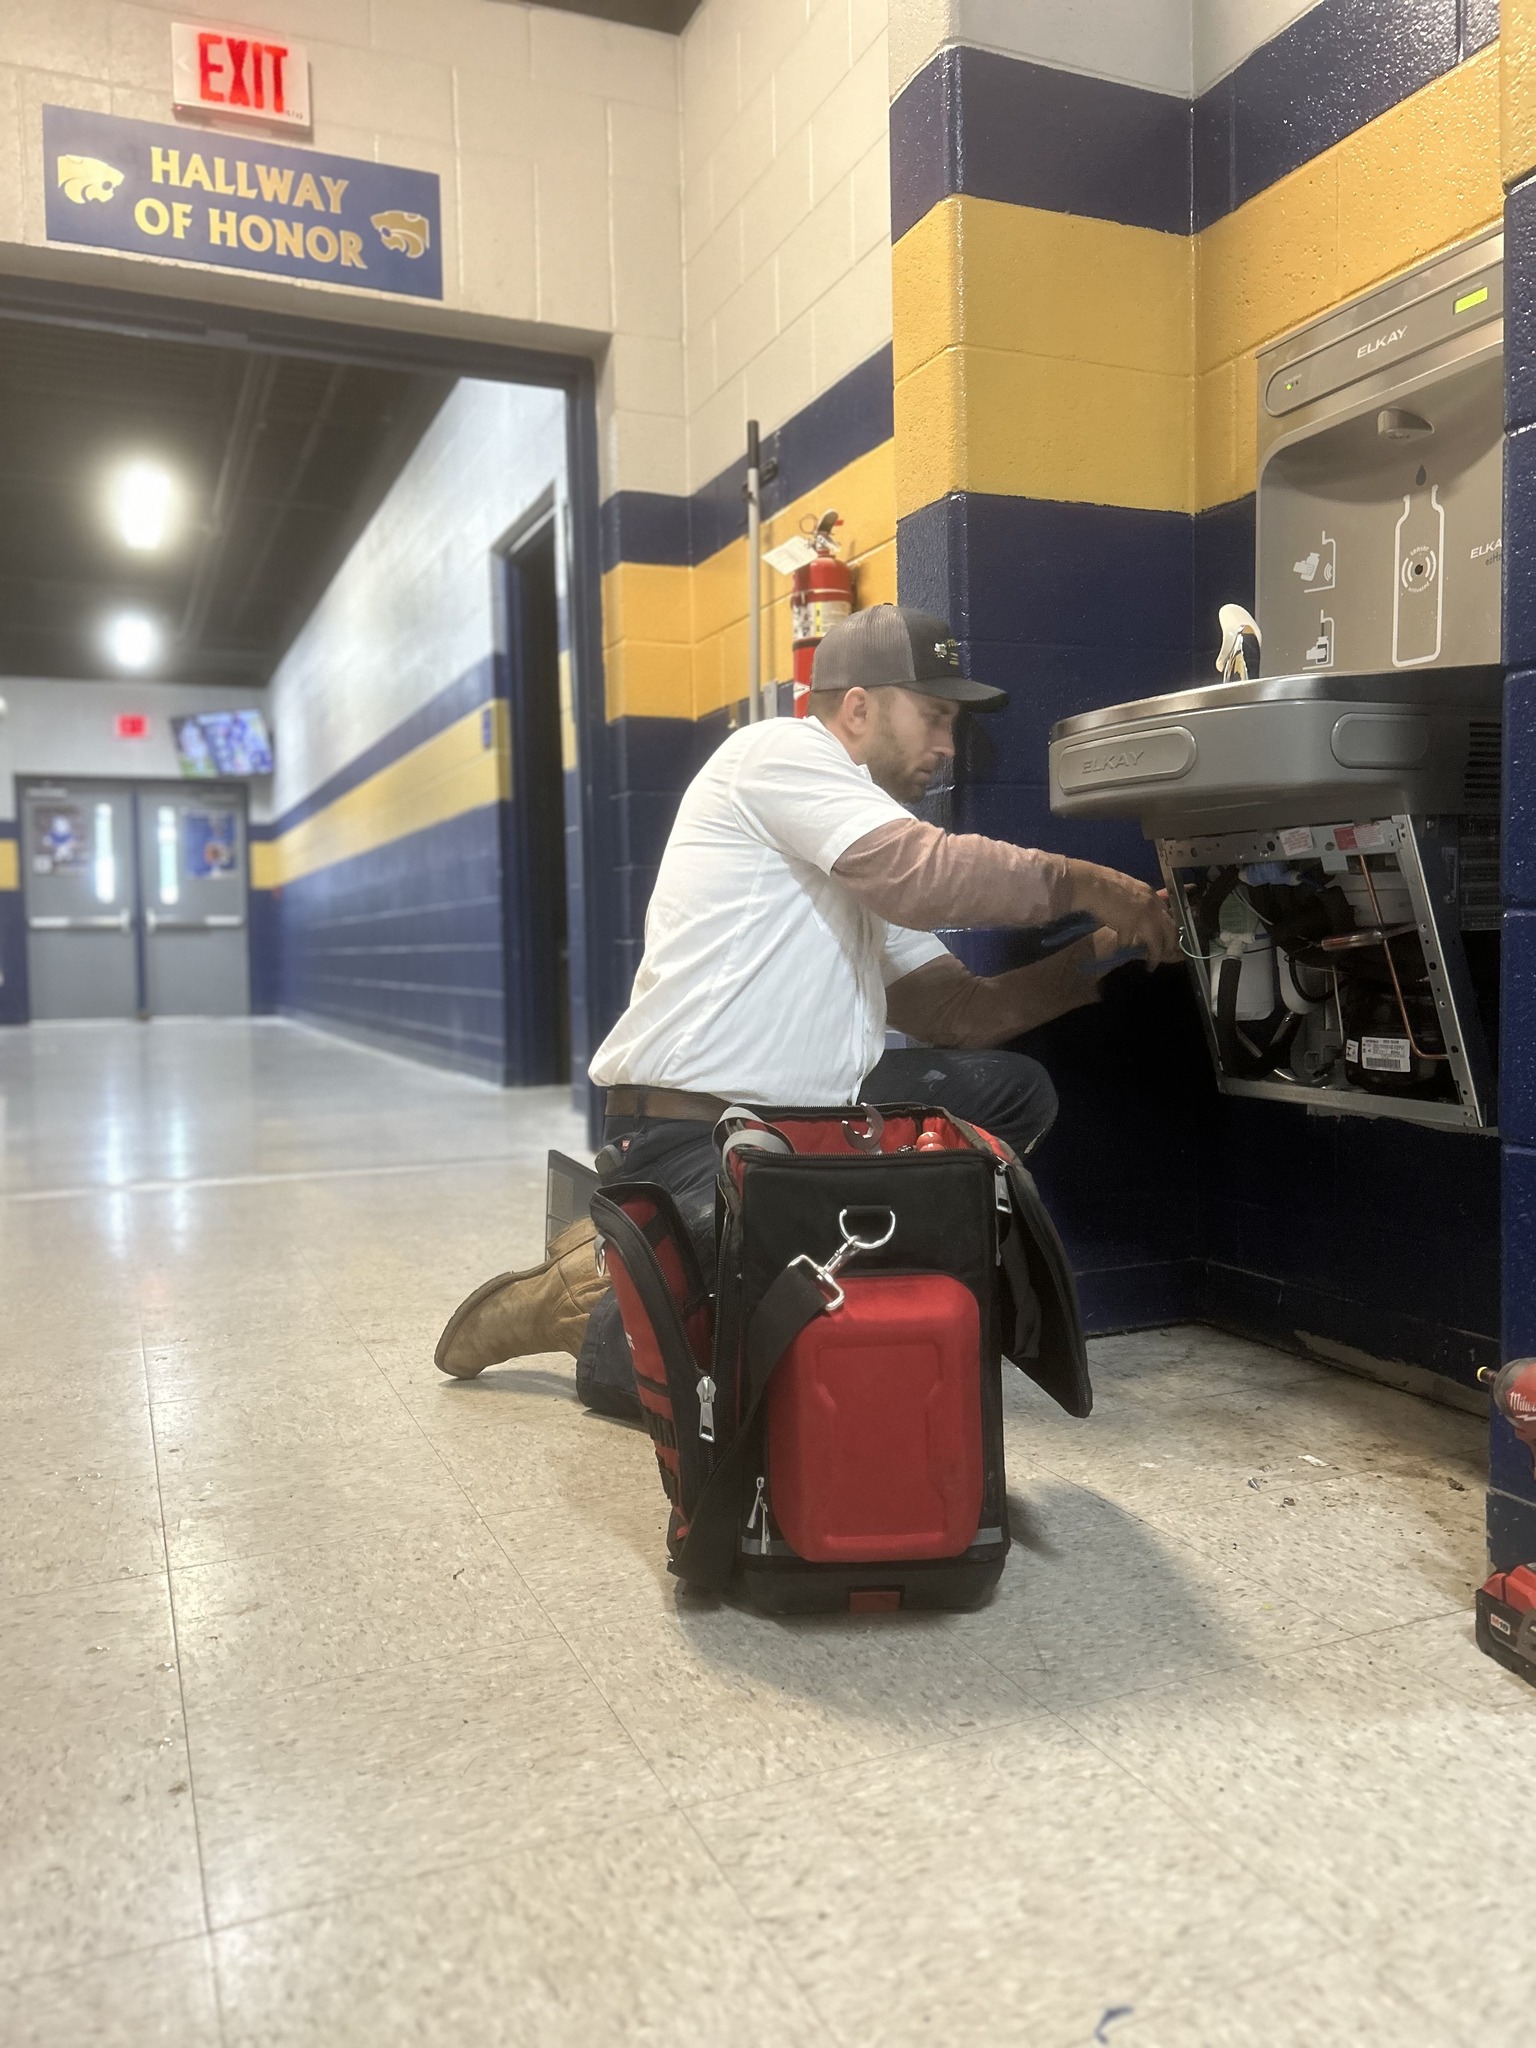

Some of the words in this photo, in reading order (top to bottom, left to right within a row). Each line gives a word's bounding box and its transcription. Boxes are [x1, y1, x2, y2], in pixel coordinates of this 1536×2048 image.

[197, 32, 289, 113] EXIT
[150, 146, 349, 214] HALLWAY
[134, 197, 193, 239] OF
[208, 207, 368, 270] HONOR
[1357, 325, 1408, 358] ELKAY
[1082, 750, 1145, 774] ELKAY
